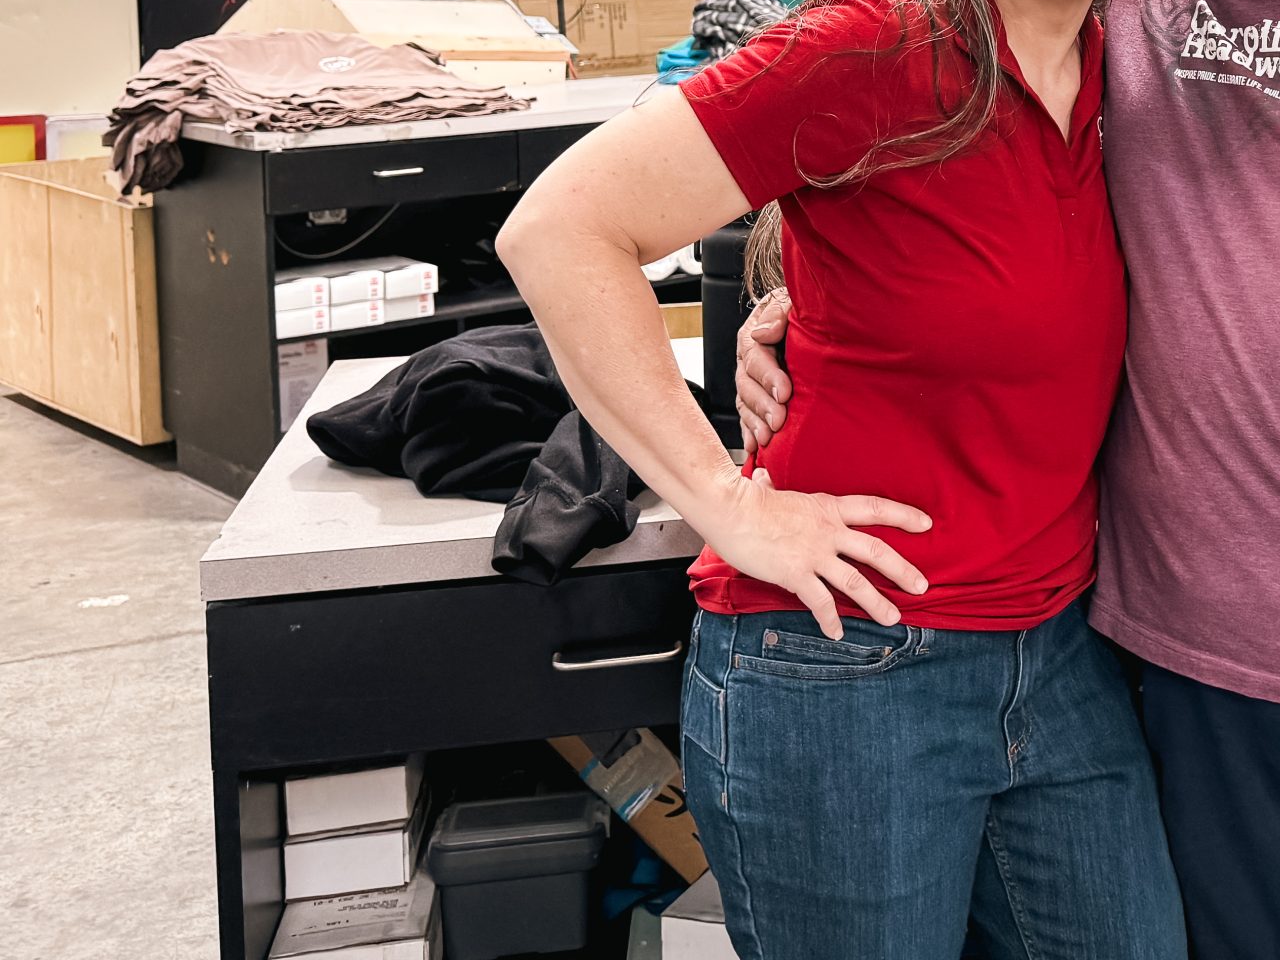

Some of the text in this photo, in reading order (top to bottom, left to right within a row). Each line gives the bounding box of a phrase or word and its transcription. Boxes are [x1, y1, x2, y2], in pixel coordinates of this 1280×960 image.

[1173, 68, 1197, 80] INSPIRE
[1197, 70, 1217, 82] PRIDE.
[1218, 72, 1247, 86] CELEBRATE
[1246, 78, 1263, 91] LIFE.
